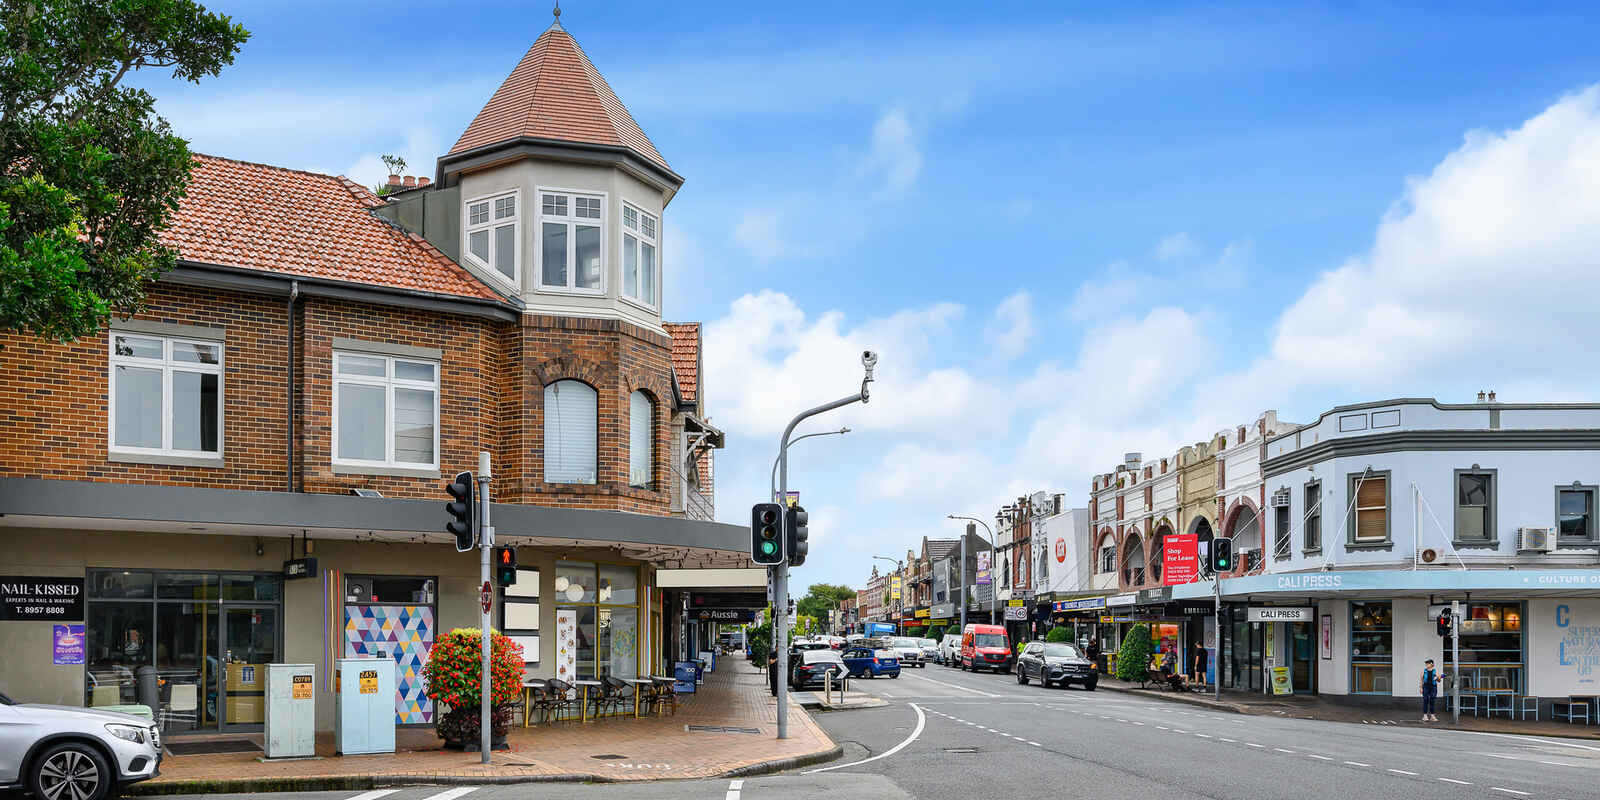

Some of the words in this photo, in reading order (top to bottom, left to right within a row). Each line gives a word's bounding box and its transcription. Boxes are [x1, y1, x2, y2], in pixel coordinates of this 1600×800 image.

[1167, 548, 1182, 556] Shop
[1278, 577, 1301, 588] CALI
[1303, 575, 1342, 587] PRESS
[1538, 576, 1586, 584] CULTURE
[1, 583, 79, 596] NAIL-KISSED
[16, 606, 23, 614] T.
[25, 606, 44, 614] 8957
[1260, 610, 1277, 618] CALI
[1277, 610, 1301, 618] PRESS
[711, 610, 739, 619] Aussie
